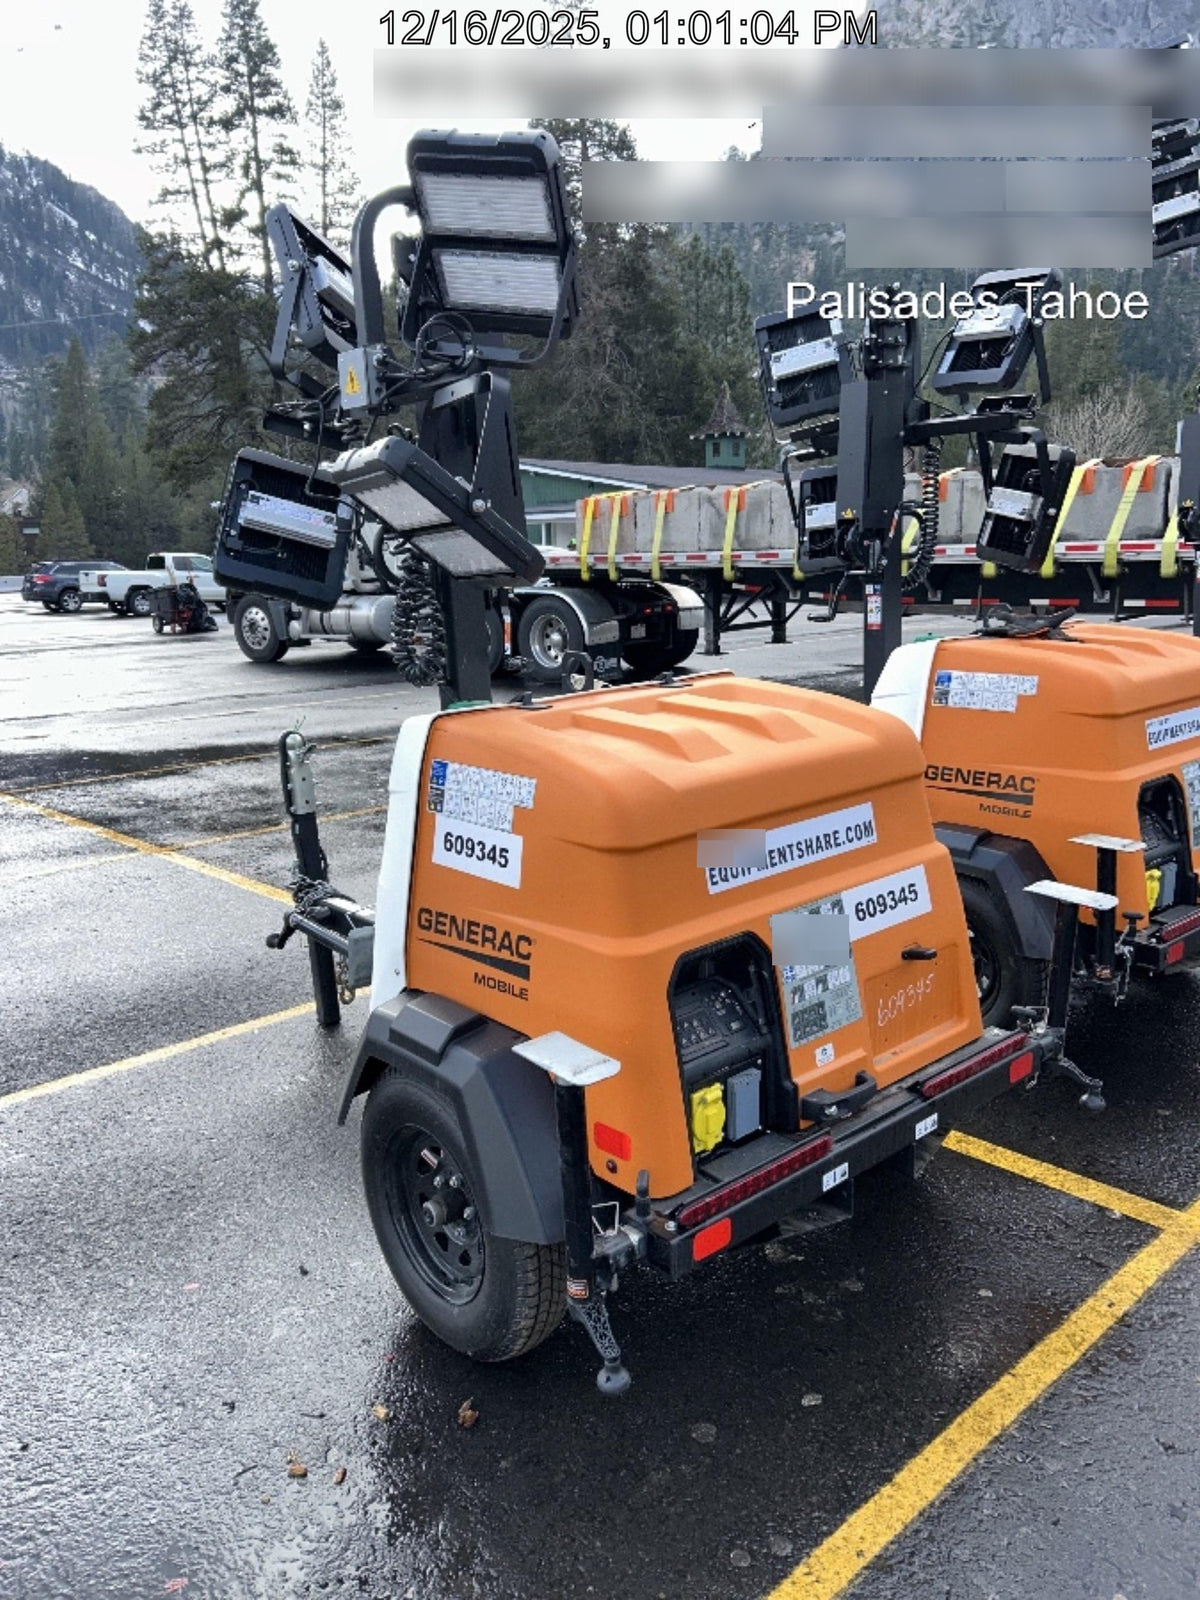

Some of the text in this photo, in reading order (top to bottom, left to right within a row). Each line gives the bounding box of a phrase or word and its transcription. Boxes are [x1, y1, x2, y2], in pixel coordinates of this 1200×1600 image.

[924, 764, 1036, 794] GENERAC
[979, 803, 1032, 818] MOBILE
[443, 831, 509, 868] 609345
[855, 882, 919, 922] 609345
[416, 907, 533, 961] GENERAC
[473, 971, 529, 1001] MOBILE
